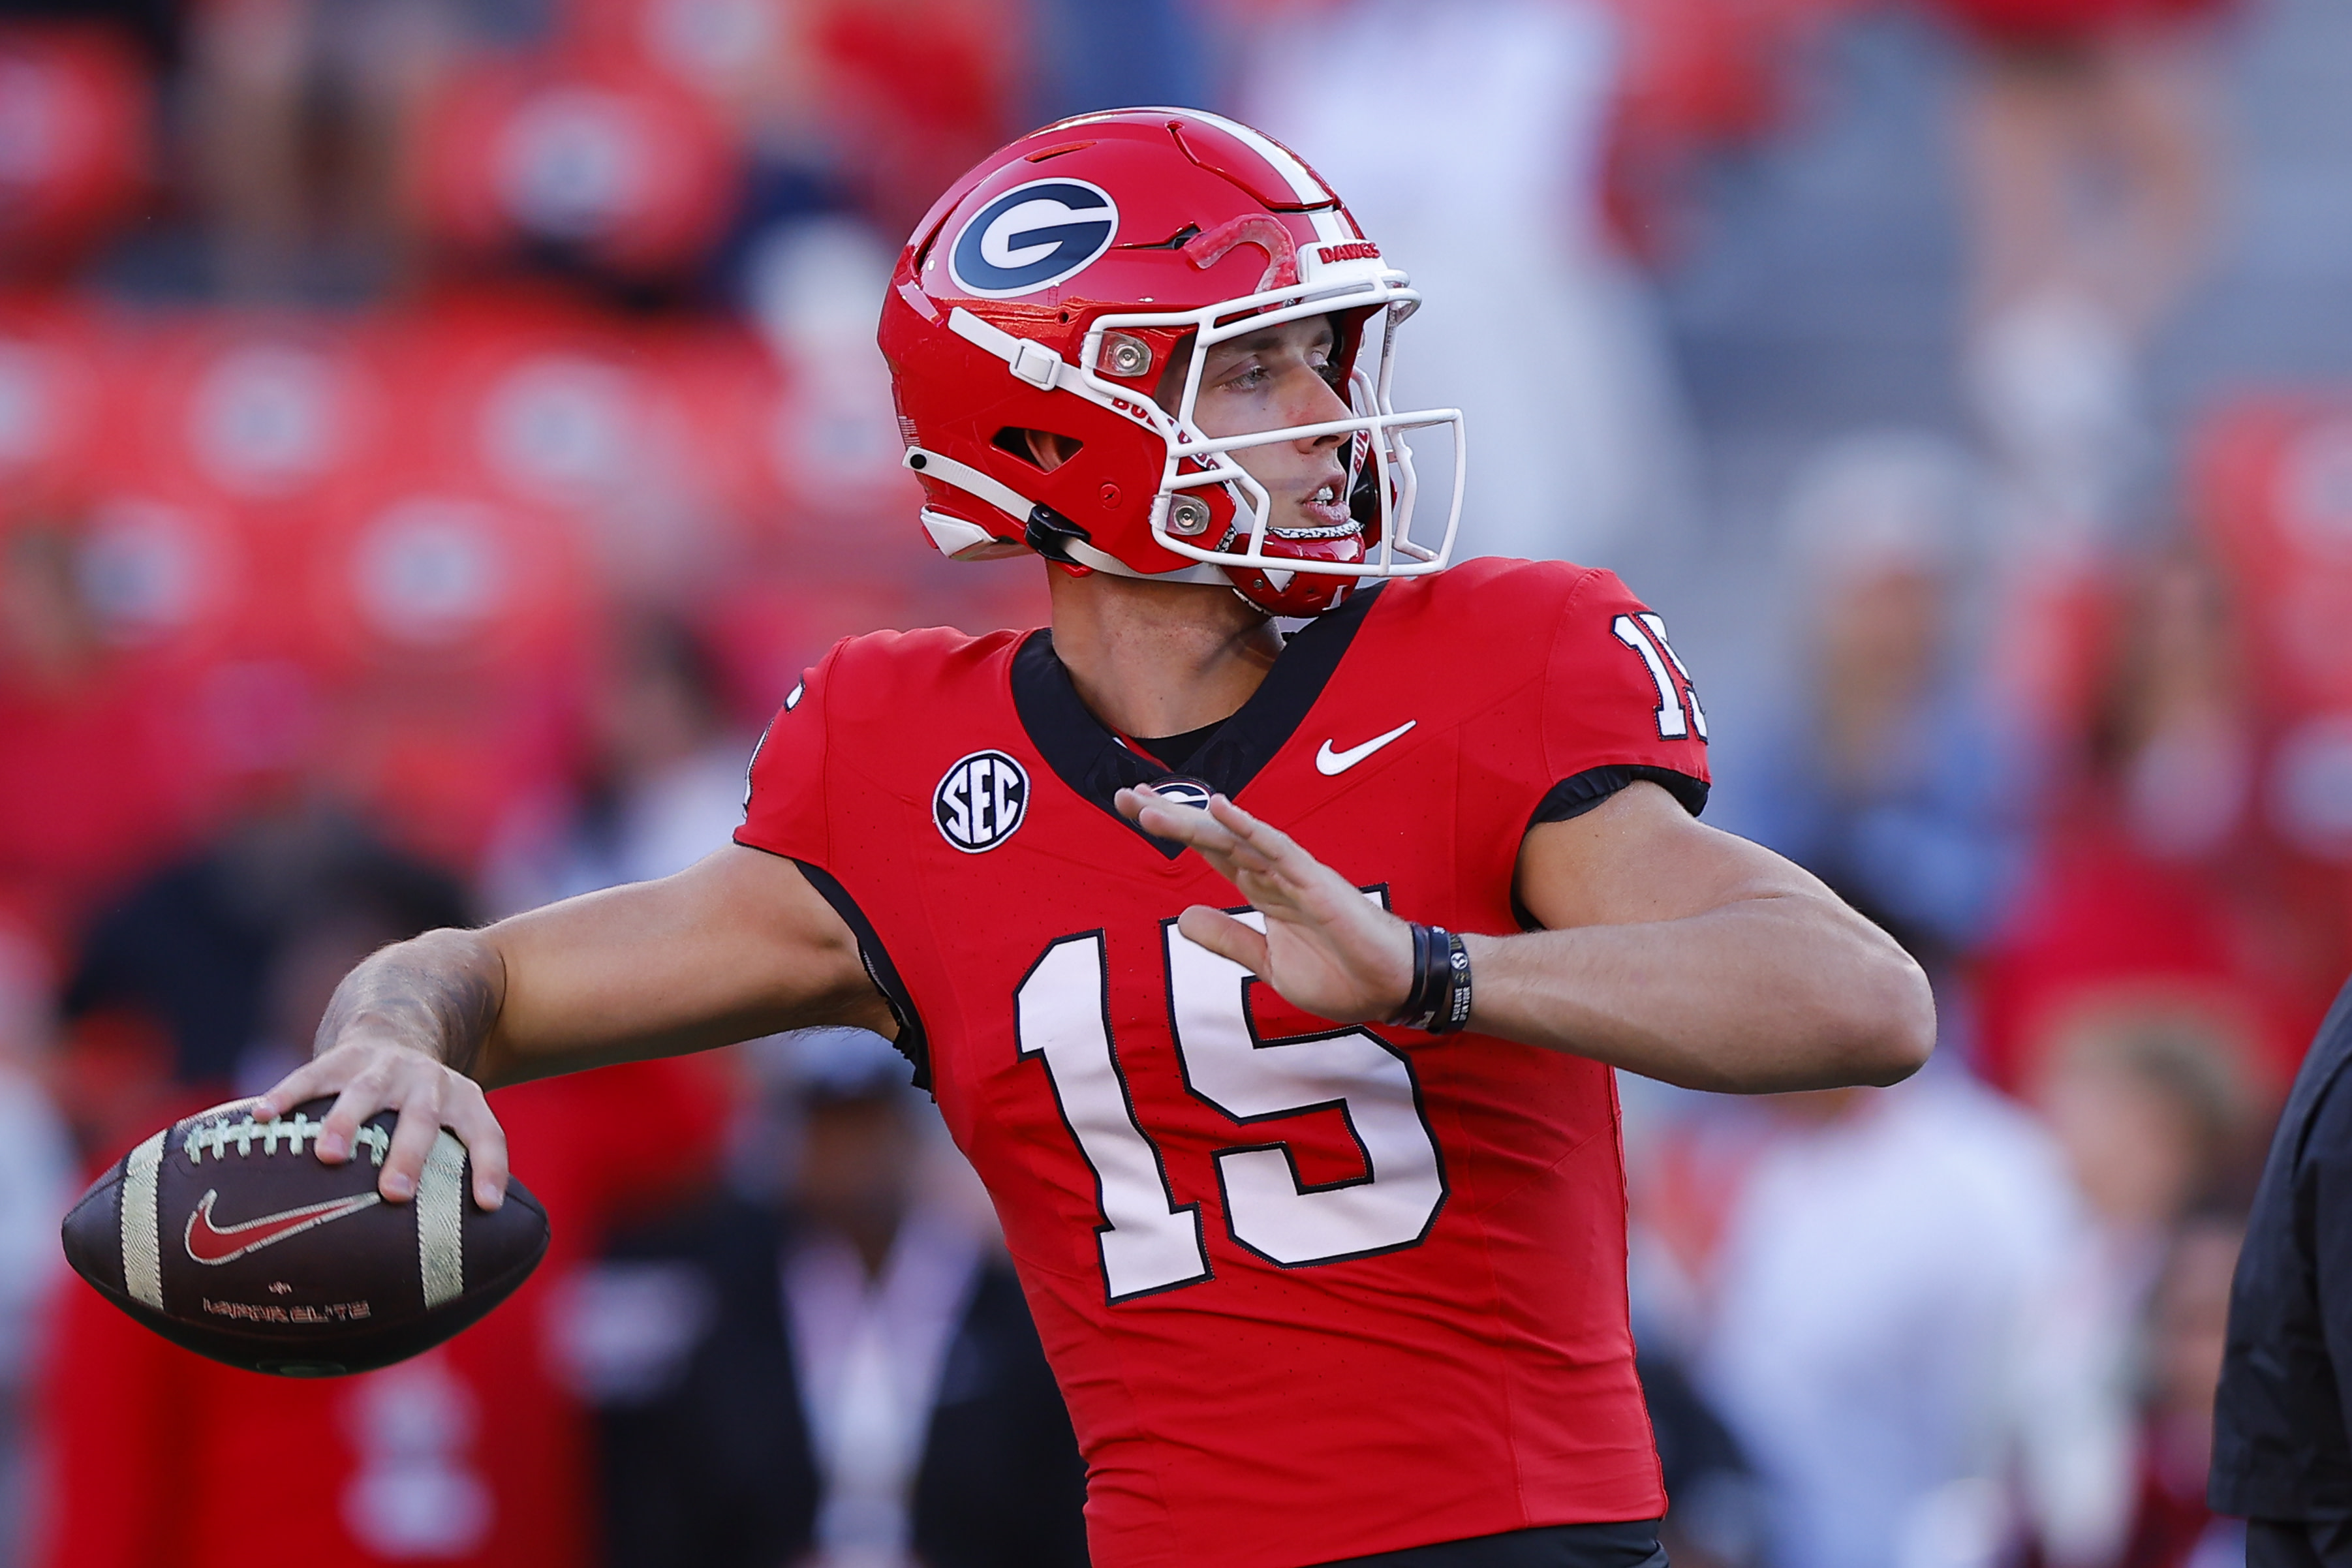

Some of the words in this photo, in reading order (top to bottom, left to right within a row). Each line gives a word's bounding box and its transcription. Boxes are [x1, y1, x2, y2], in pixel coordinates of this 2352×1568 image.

[953, 183, 1113, 291] G
[1317, 242, 1381, 264] DAWGS
[942, 758, 1019, 844] SEC
[1013, 882, 1451, 1306] 15
